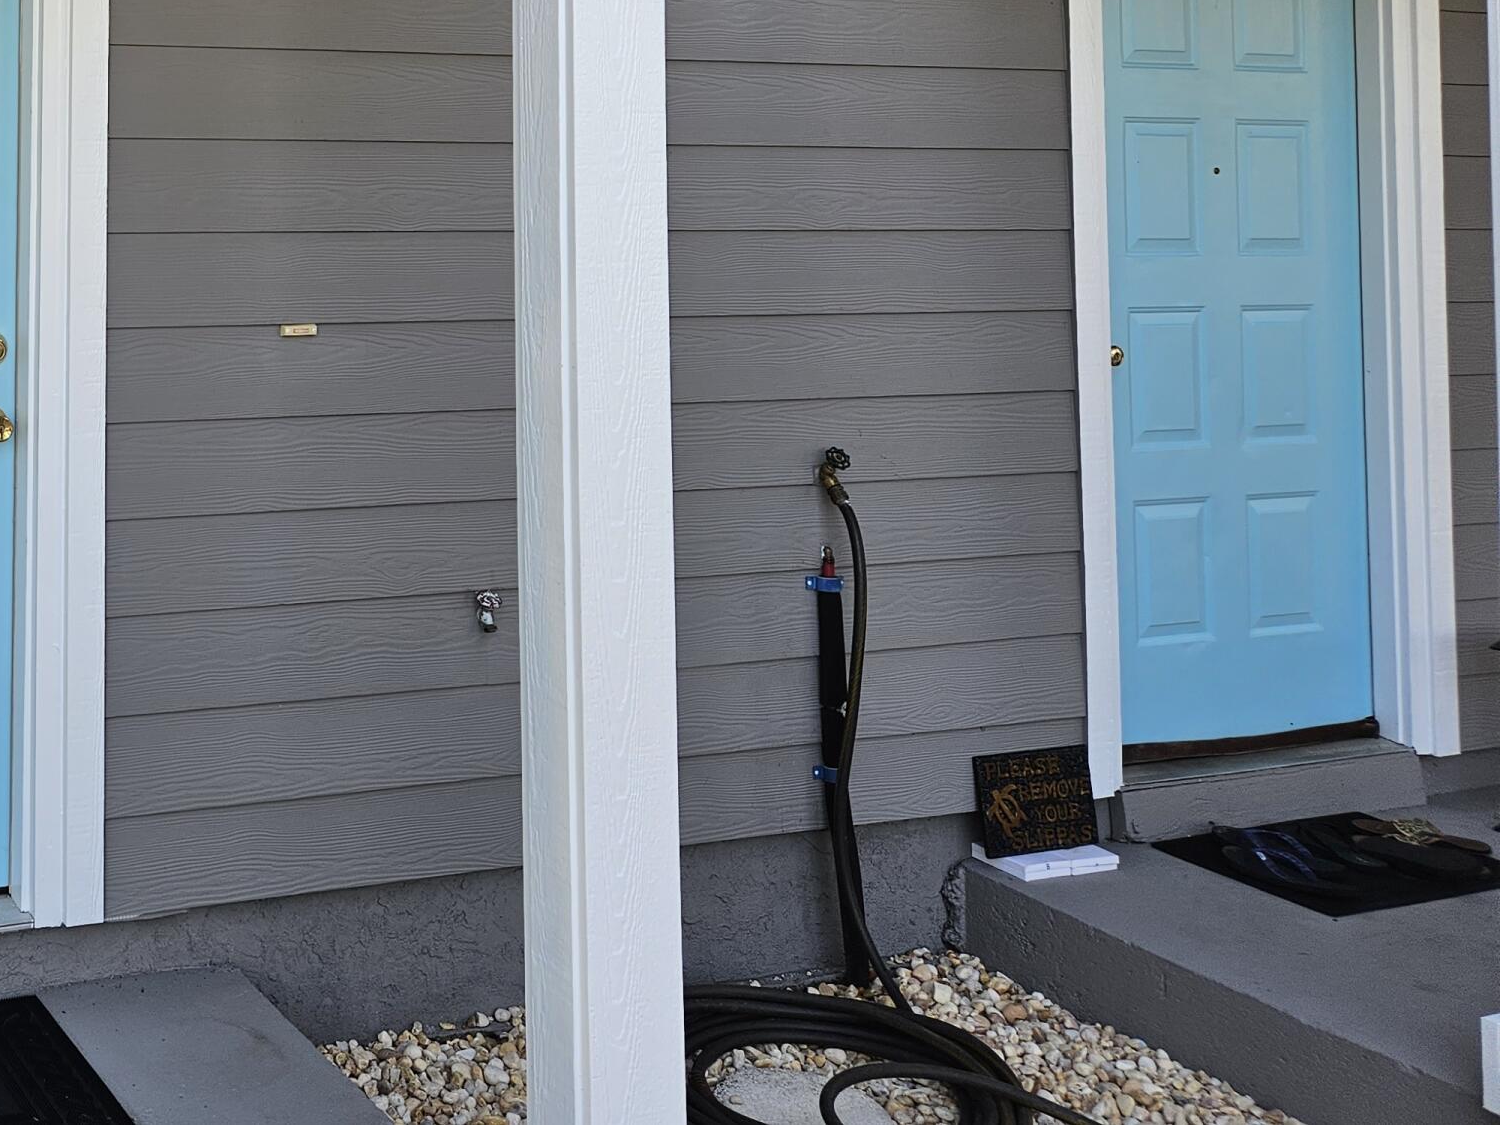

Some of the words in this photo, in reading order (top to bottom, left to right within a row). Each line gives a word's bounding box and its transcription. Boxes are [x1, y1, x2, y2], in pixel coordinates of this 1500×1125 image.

[984, 754, 1061, 780] PLEASE
[1018, 776, 1090, 802] REMOVE
[1034, 802, 1082, 822] YOUR
[1011, 824, 1093, 850] SLIPPAS
